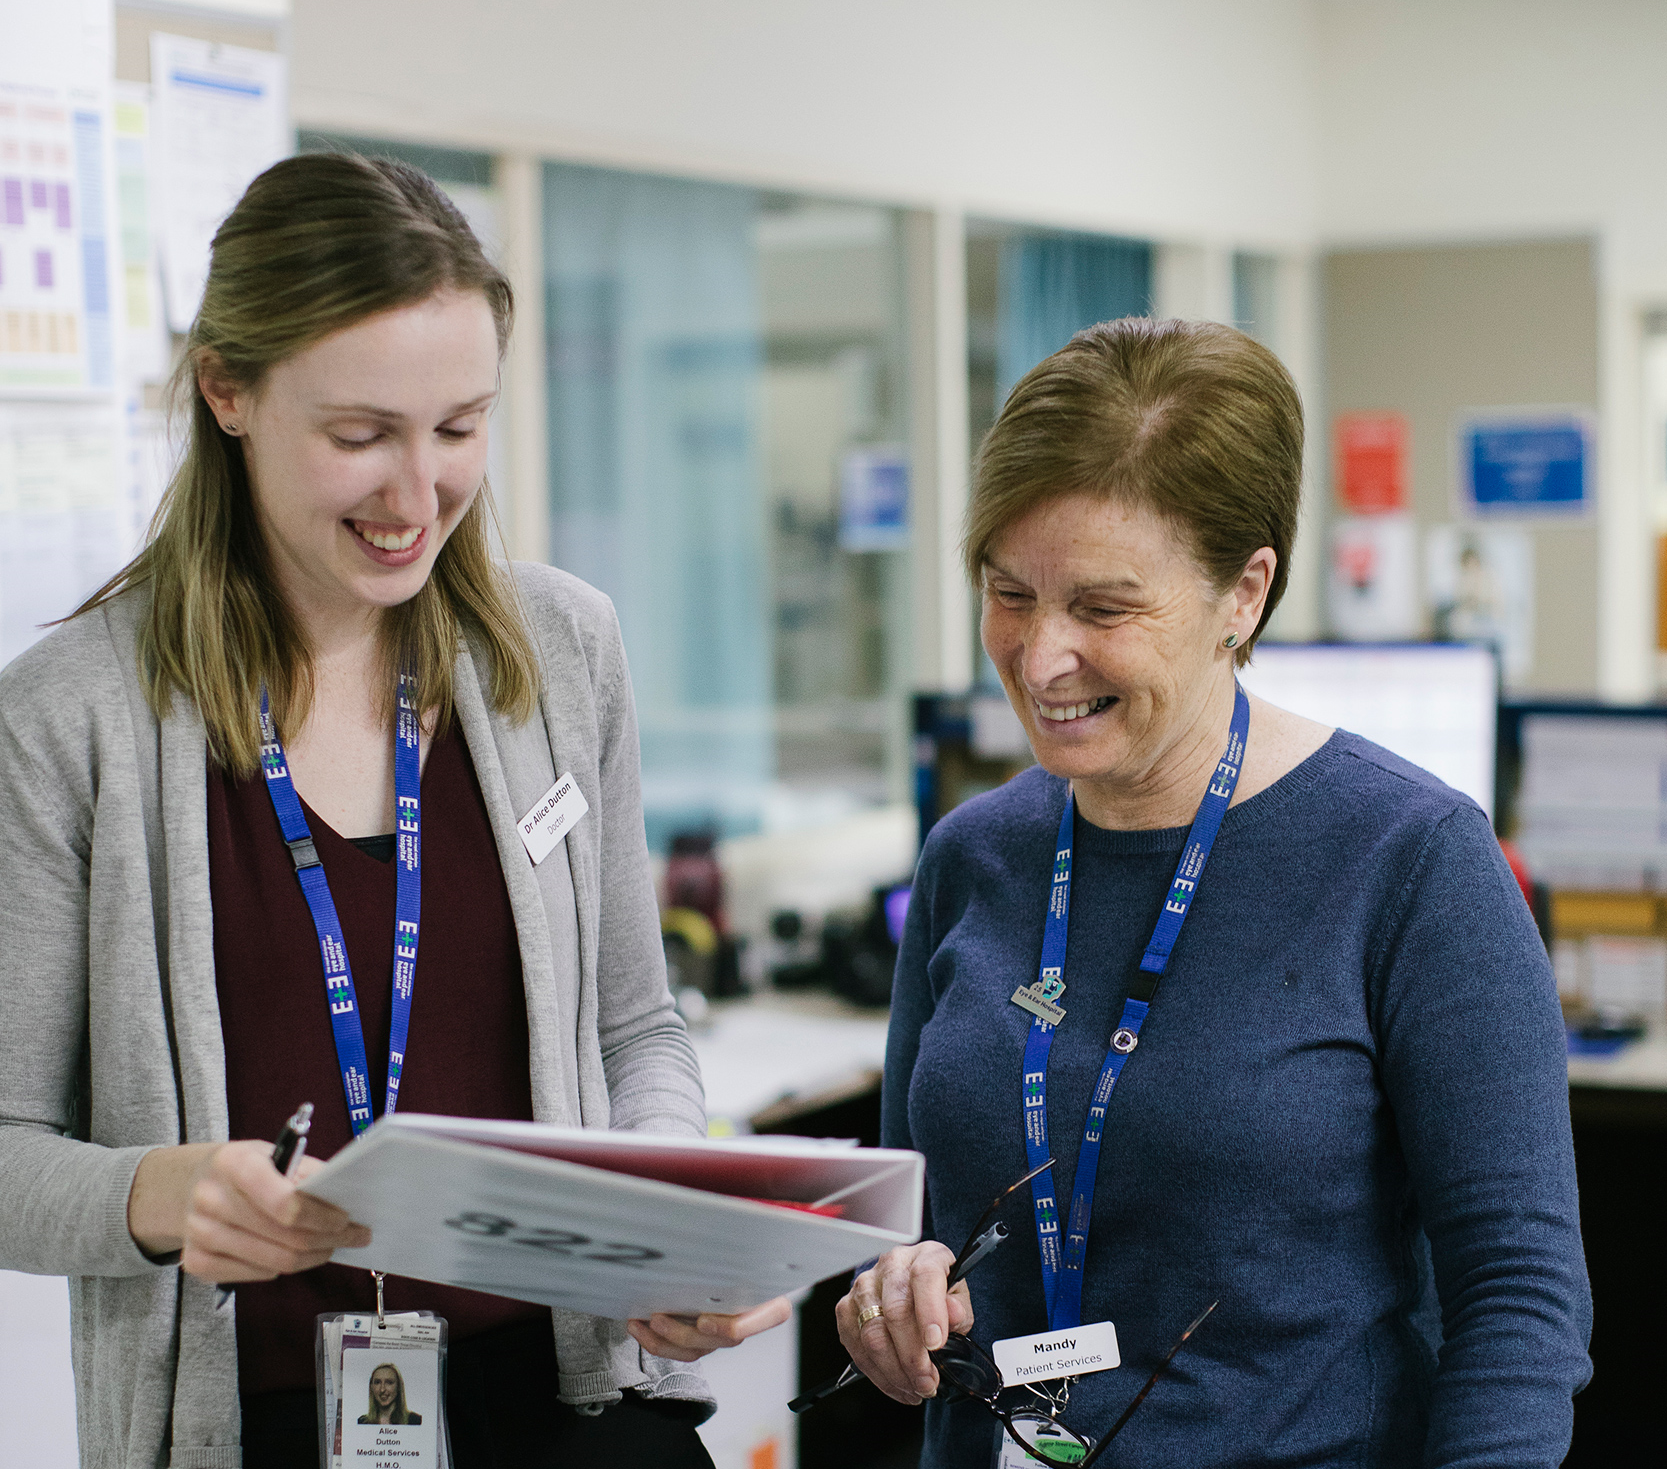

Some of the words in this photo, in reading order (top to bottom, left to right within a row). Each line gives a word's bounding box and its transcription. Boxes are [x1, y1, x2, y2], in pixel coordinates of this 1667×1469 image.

[524, 822, 534, 834] Dr
[533, 805, 550, 825] Alice
[548, 782, 571, 808] Dutton
[547, 814, 566, 835] Doctor
[1185, 865, 1193, 876] eye
[1191, 853, 1204, 878] hospital
[1050, 887, 1058, 912] hospital
[328, 946, 336, 959] and
[334, 942, 346, 971] hospital
[1019, 989, 1028, 997] Eye
[1032, 996, 1041, 1004] Ear
[1041, 1001, 1062, 1016] Hospital
[358, 1074, 367, 1103] hospital
[1034, 1339, 1077, 1354] Mandy
[1016, 1362, 1054, 1376] Patient
[1056, 1354, 1102, 1370] Services
[376, 1438, 401, 1446] Dutton
[387, 1449, 420, 1457] Services
